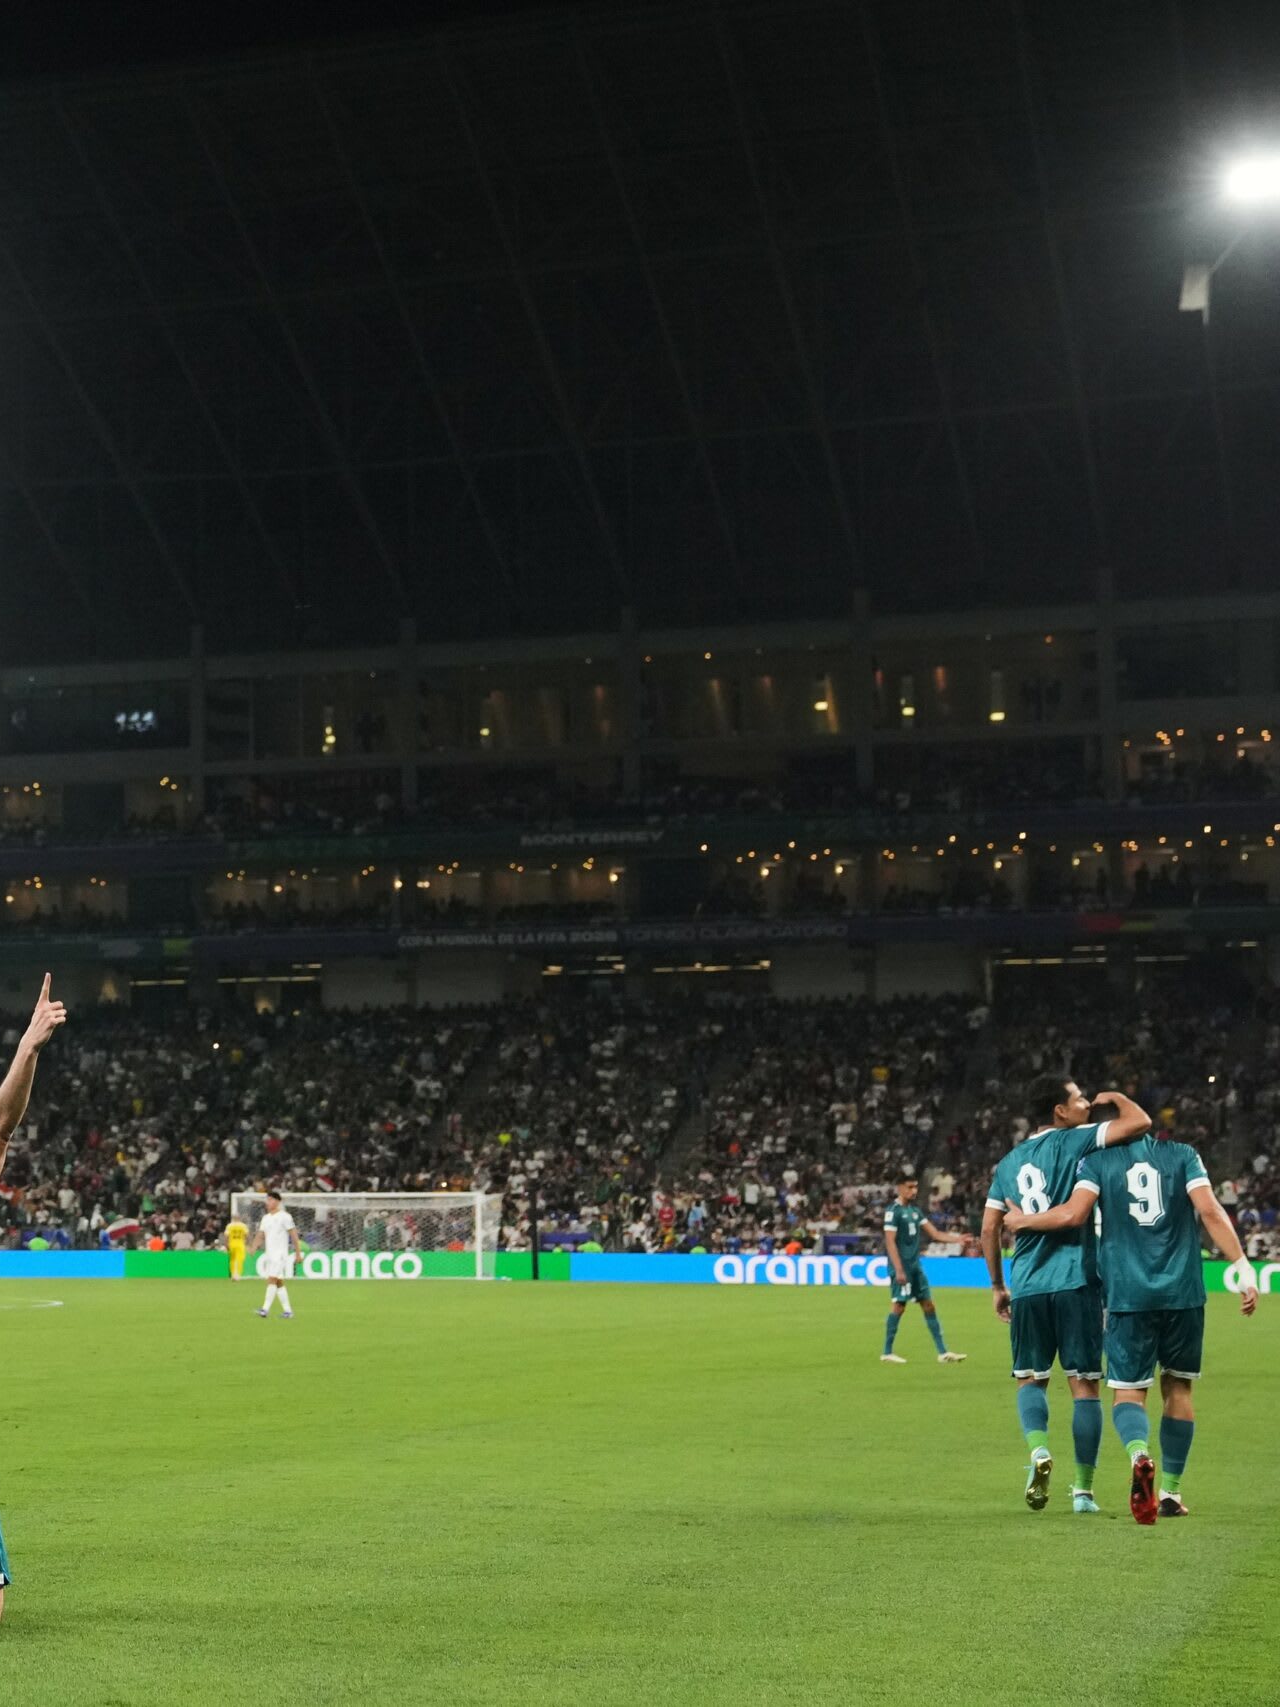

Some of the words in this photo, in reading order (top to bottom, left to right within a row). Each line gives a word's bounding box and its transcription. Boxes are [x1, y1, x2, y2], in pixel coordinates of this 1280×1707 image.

[521, 831, 665, 846] MONTERREY
[1016, 1162, 1051, 1216] 8
[1126, 1161, 1165, 1226] 9
